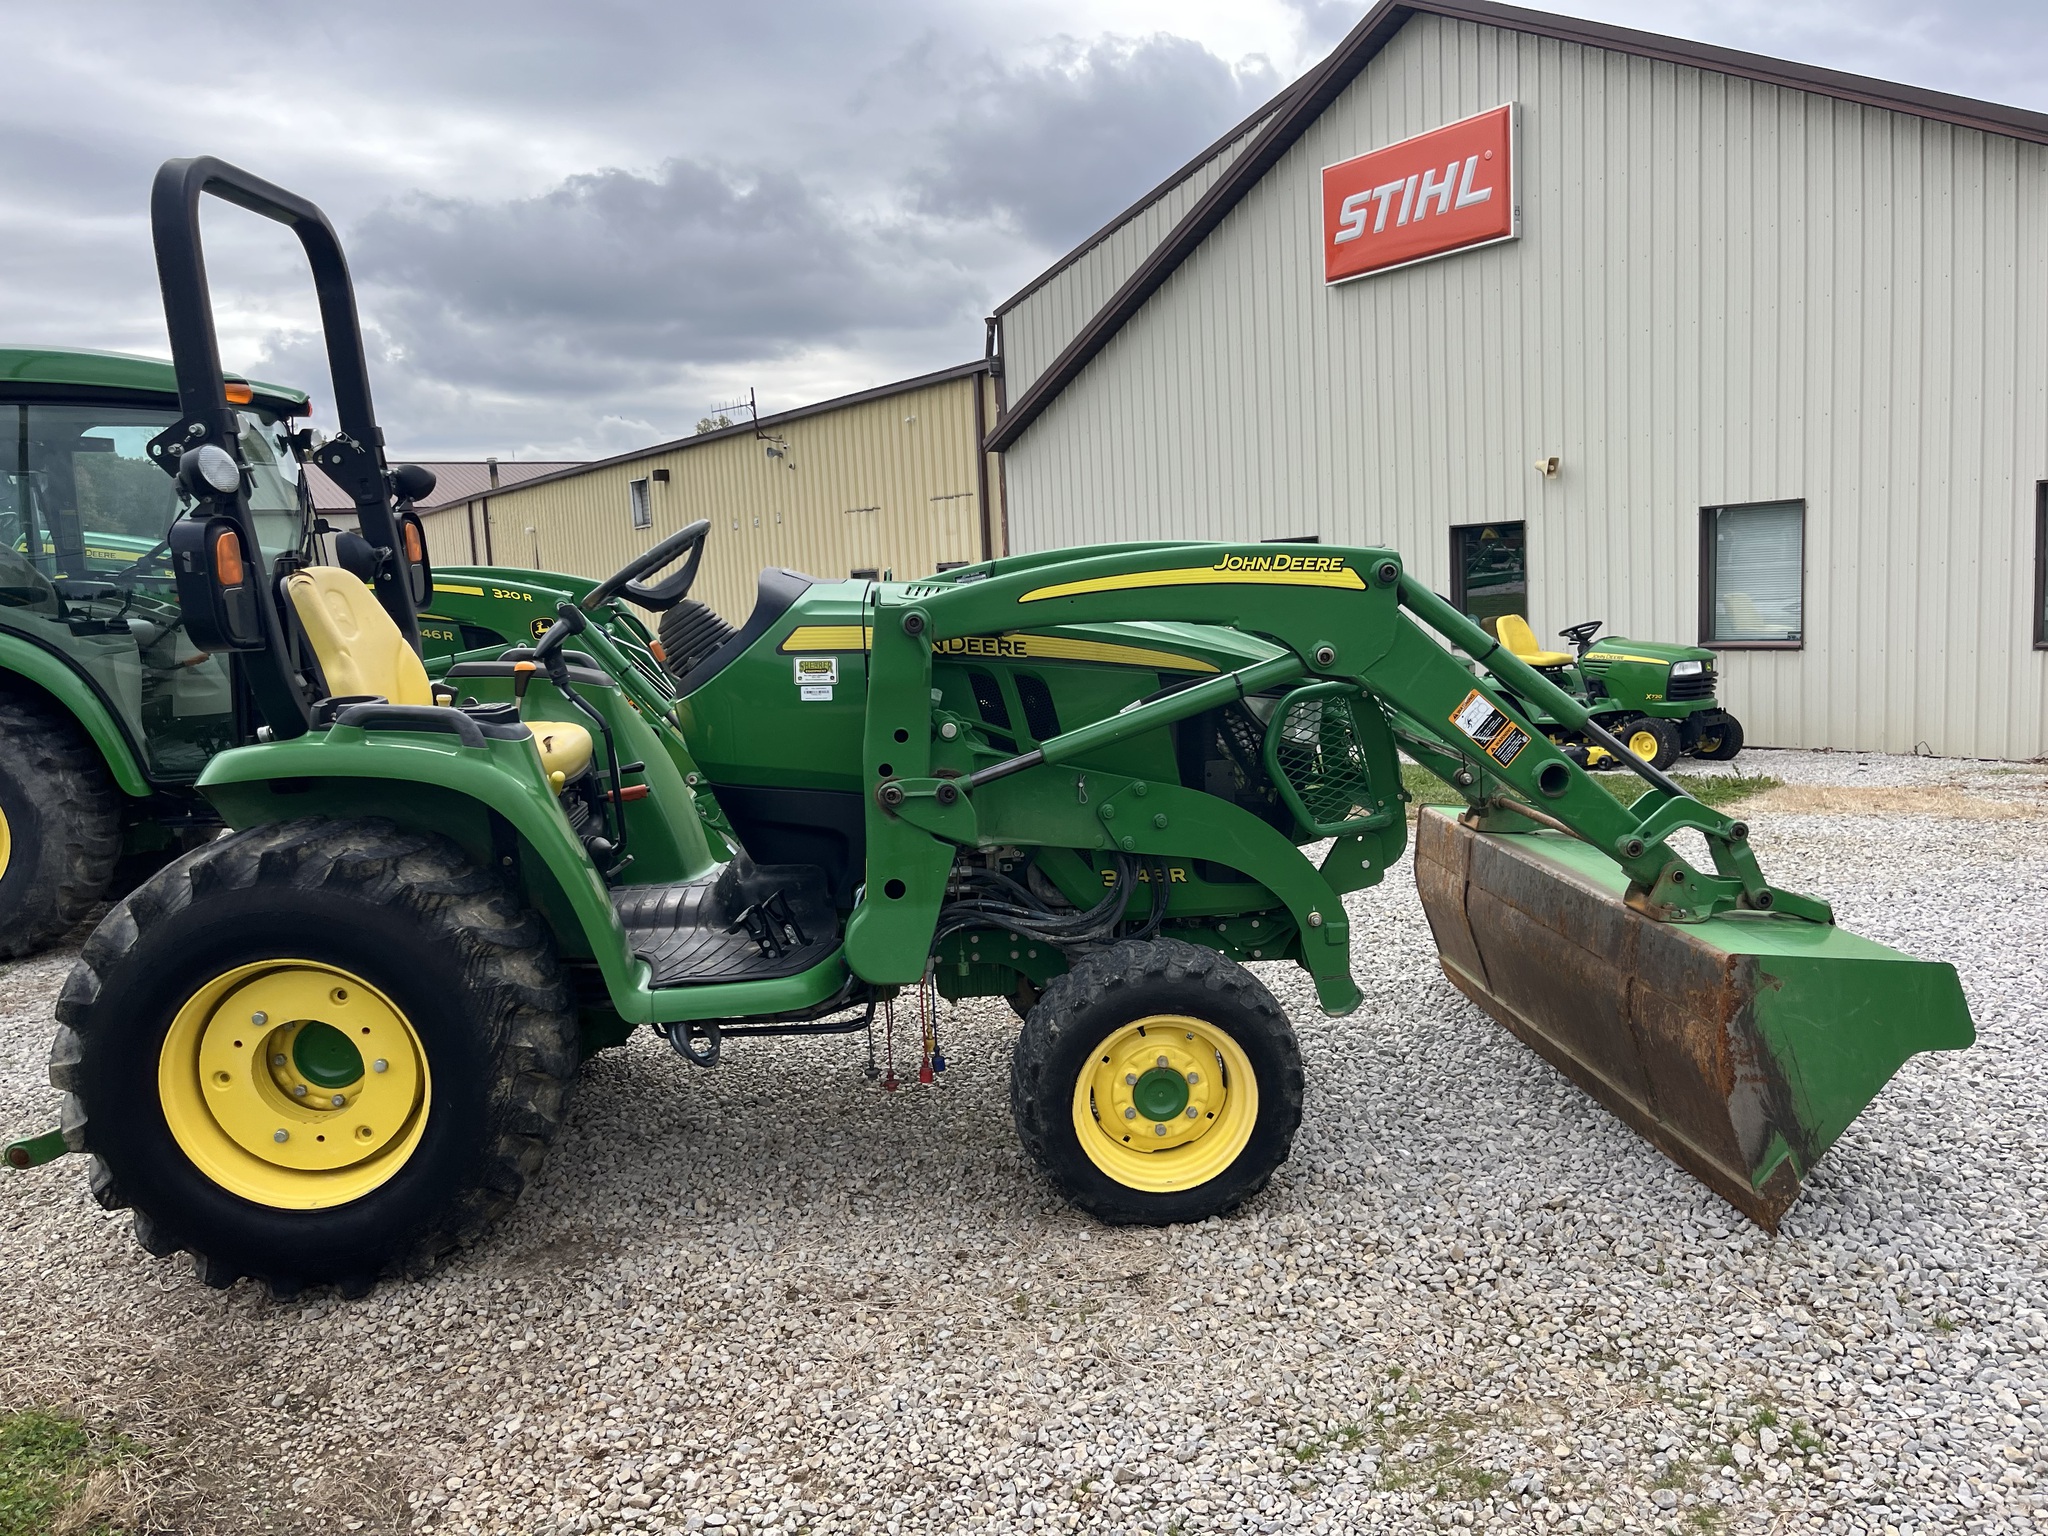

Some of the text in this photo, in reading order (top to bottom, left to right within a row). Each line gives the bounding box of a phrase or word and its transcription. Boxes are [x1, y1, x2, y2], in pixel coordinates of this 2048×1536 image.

[1334, 155, 1493, 245] STIHL
[1213, 553, 1344, 571] JOHN DEERE
[492, 588, 533, 602] 320 R
[420, 629, 454, 641] 46 R
[948, 637, 1027, 656] DEERE
[1169, 867, 1187, 883] R
